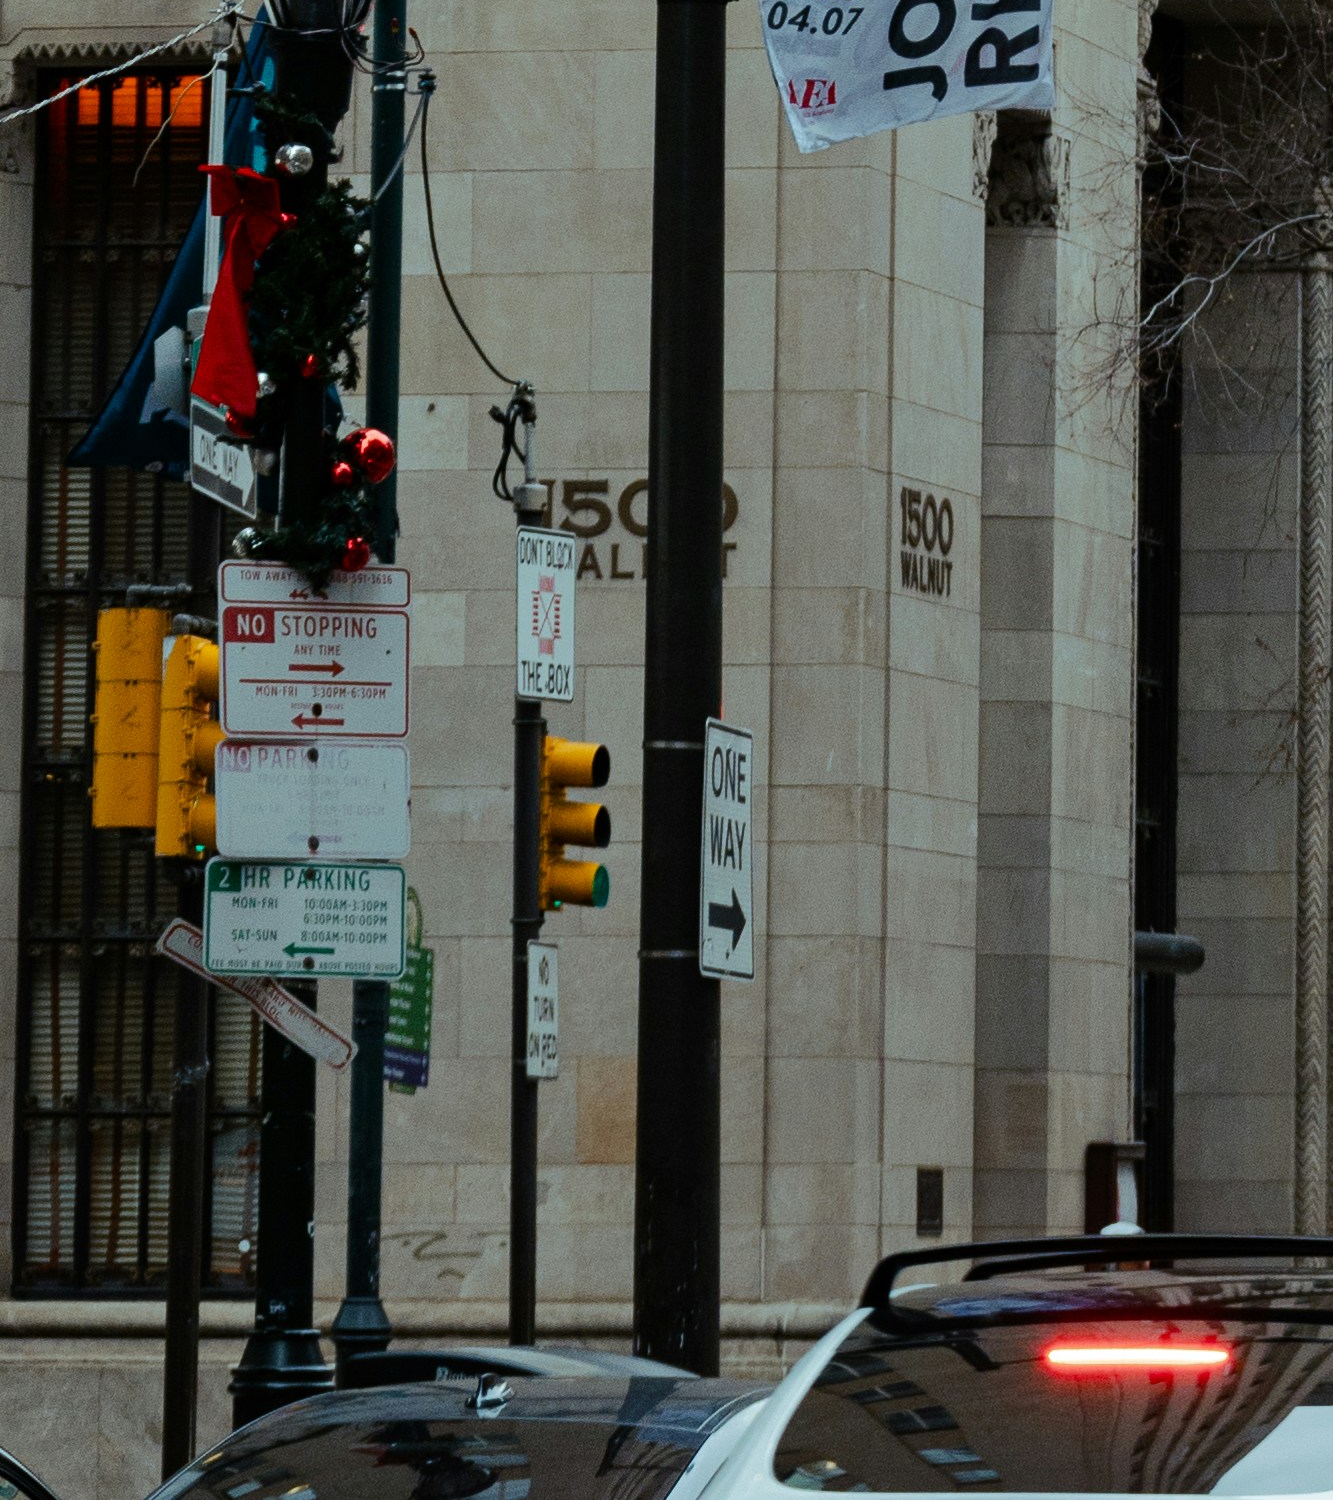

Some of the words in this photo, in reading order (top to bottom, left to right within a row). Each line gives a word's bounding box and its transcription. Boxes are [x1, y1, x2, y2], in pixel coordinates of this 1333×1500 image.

[767, 0, 863, 36] 04.07
[201, 434, 218, 470] ONE
[900, 486, 954, 556] 1500
[546, 540, 574, 569] BLOCK
[240, 570, 260, 580] TOW
[265, 570, 293, 581] AWAY
[900, 551, 953, 597] WALNUT
[236, 613, 266, 636] NO
[281, 615, 378, 639] STOPPING
[294, 644, 314, 656] ANY
[319, 645, 341, 656] TIME
[521, 660, 543, 692] THE
[548, 663, 571, 695] BOX
[255, 686, 298, 697] MON-FRI
[219, 746, 250, 769] NO
[711, 745, 747, 804] ONE
[710, 813, 746, 871] WAY
[218, 866, 231, 888] 2
[243, 866, 271, 889] HR
[284, 868, 371, 892] PARKING
[231, 897, 279, 909] MON-FRI
[231, 929, 278, 942] SAT-SUN
